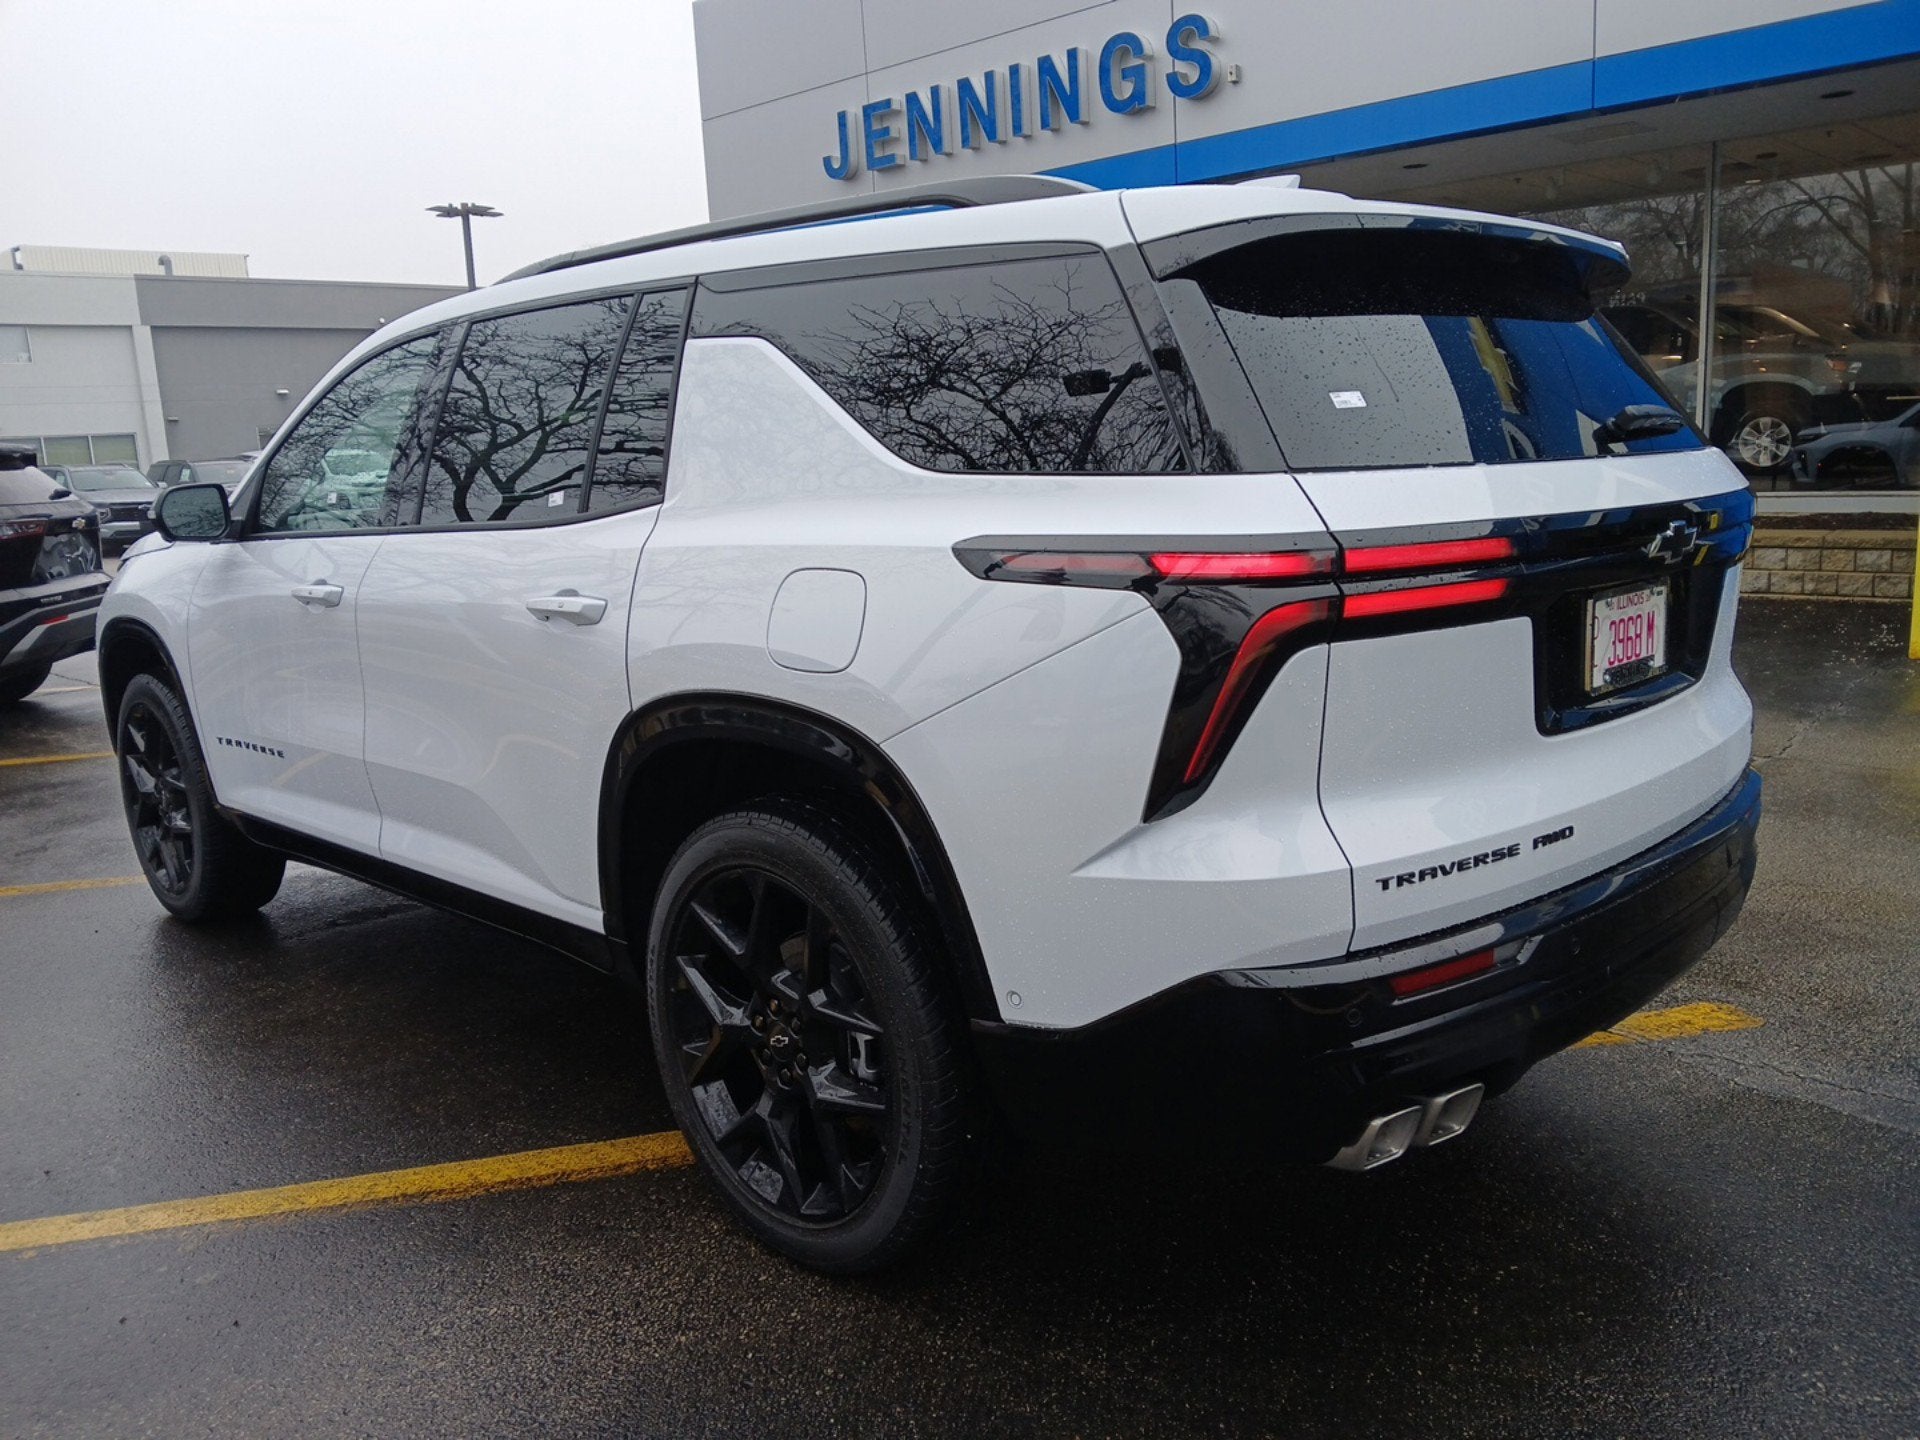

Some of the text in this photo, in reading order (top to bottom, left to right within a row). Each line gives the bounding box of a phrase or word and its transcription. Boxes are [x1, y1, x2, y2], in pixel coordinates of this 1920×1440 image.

[823, 14, 1219, 180] JENNINGS
[1616, 592, 1645, 610] ILLINOIS
[1608, 613, 1642, 666] 3968
[1647, 610, 1655, 655] M
[216, 737, 285, 758] TRAVERSE
[1376, 825, 1574, 891] TRAVERSE AWD
